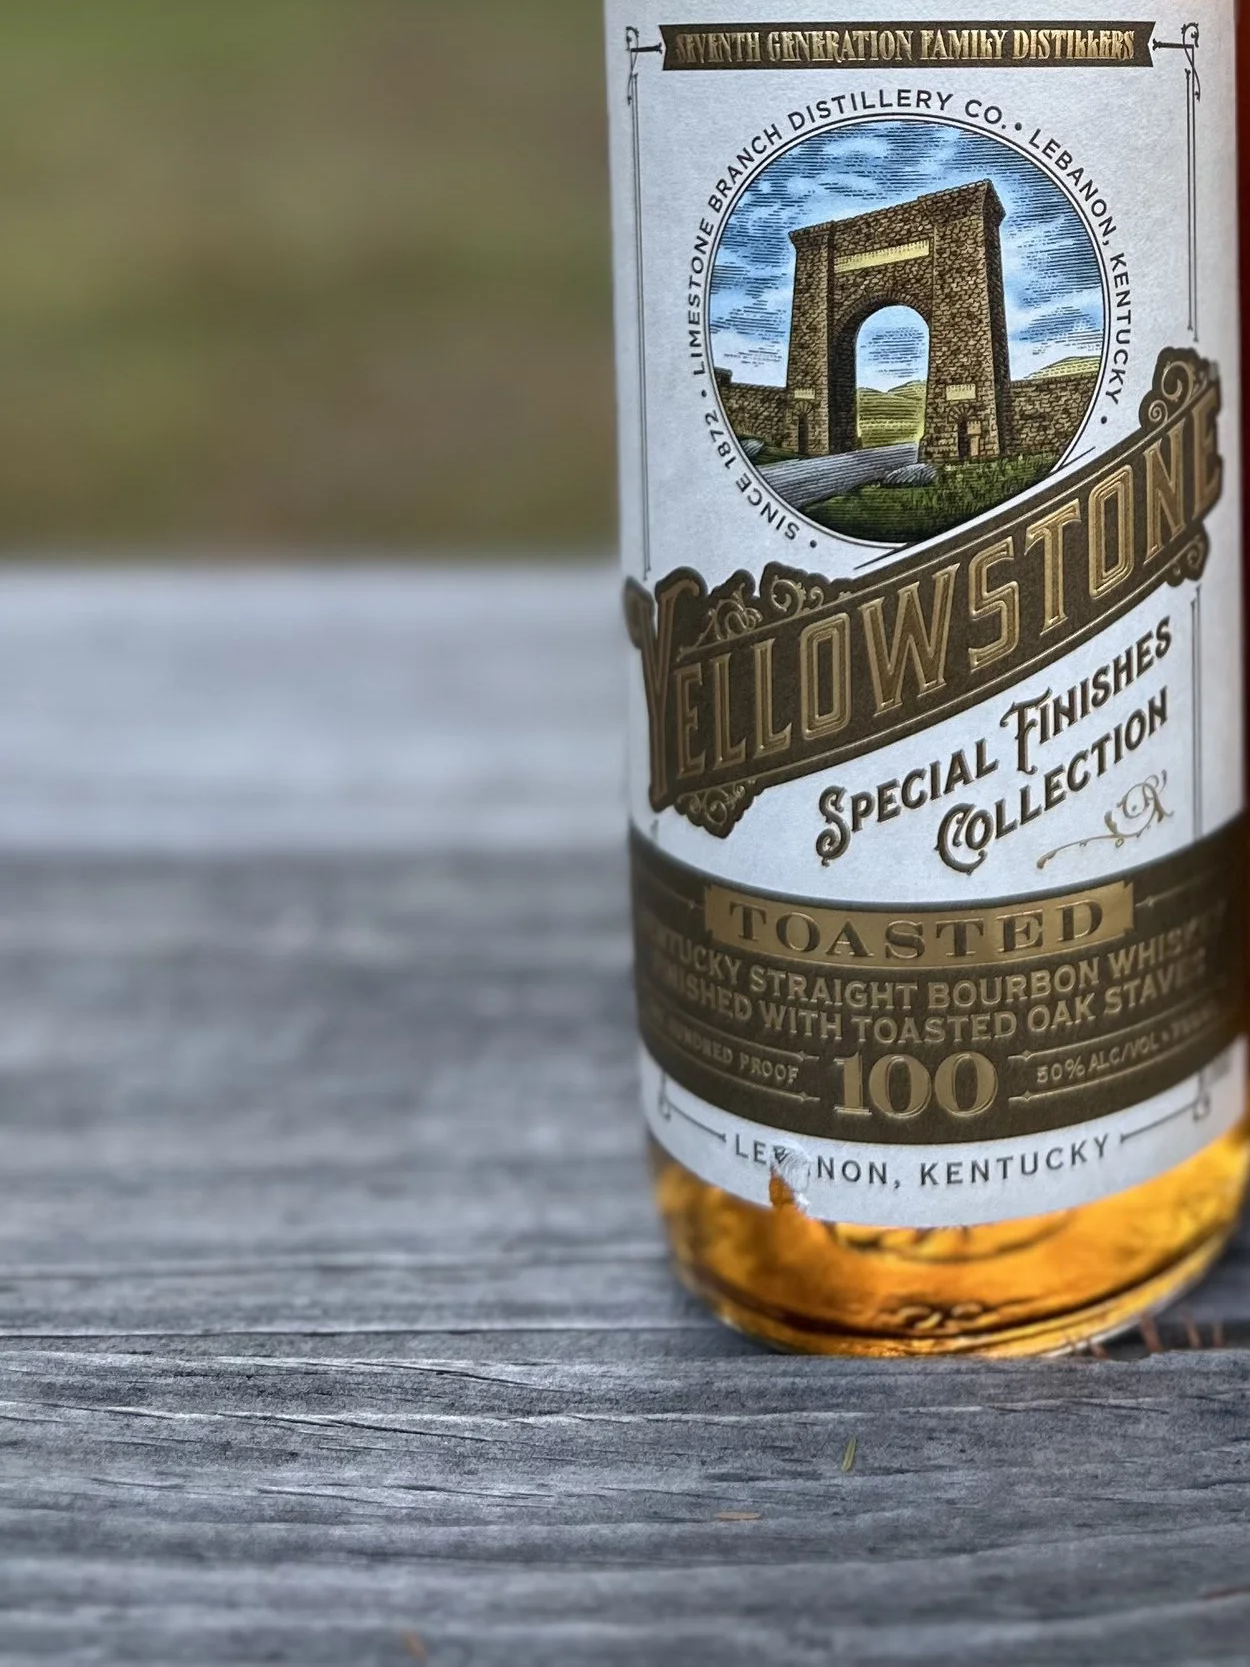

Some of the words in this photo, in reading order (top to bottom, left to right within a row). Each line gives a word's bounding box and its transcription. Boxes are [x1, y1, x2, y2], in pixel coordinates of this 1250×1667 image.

[675, 31, 761, 64] SEVENTH
[767, 30, 914, 64] GENERATION
[920, 29, 1007, 61] FAMILY
[1013, 28, 1135, 61] DISTILLERS
[686, 218, 714, 376] LIMESTONE
[707, 124, 783, 214] BRANCH
[787, 88, 955, 131] DISTILLERY
[964, 99, 1008, 131] CO.
[1028, 126, 1117, 247] LEBANON,
[1104, 251, 1132, 406] KENTUCKY
[704, 410, 739, 476] 1872
[735, 477, 801, 542] SINCE
[626, 386, 1221, 808] YELLOWSTONE
[815, 737, 1000, 866] SPECIAL
[1001, 615, 1174, 777] FINISHES
[935, 686, 1170, 873] COLLECTION
[652, 922, 742, 985] TUCKY
[750, 964, 918, 1010] STRAIGHT
[928, 955, 1100, 1010] BOURBON
[1107, 904, 1225, 980] WHISK
[729, 898, 1103, 959] TOASTED
[653, 948, 753, 1022] ISHED
[759, 999, 842, 1041] WITH
[851, 1011, 1017, 1045] TOASTED
[1028, 992, 1096, 1033] OAK
[739, 1051, 799, 1085] PROOF
[833, 1050, 998, 1120] 100
[1036, 1055, 1085, 1084] 50%
[1088, 1031, 1159, 1072] ALC/VOL
[920, 1133, 1110, 1187] KENTUCKY
